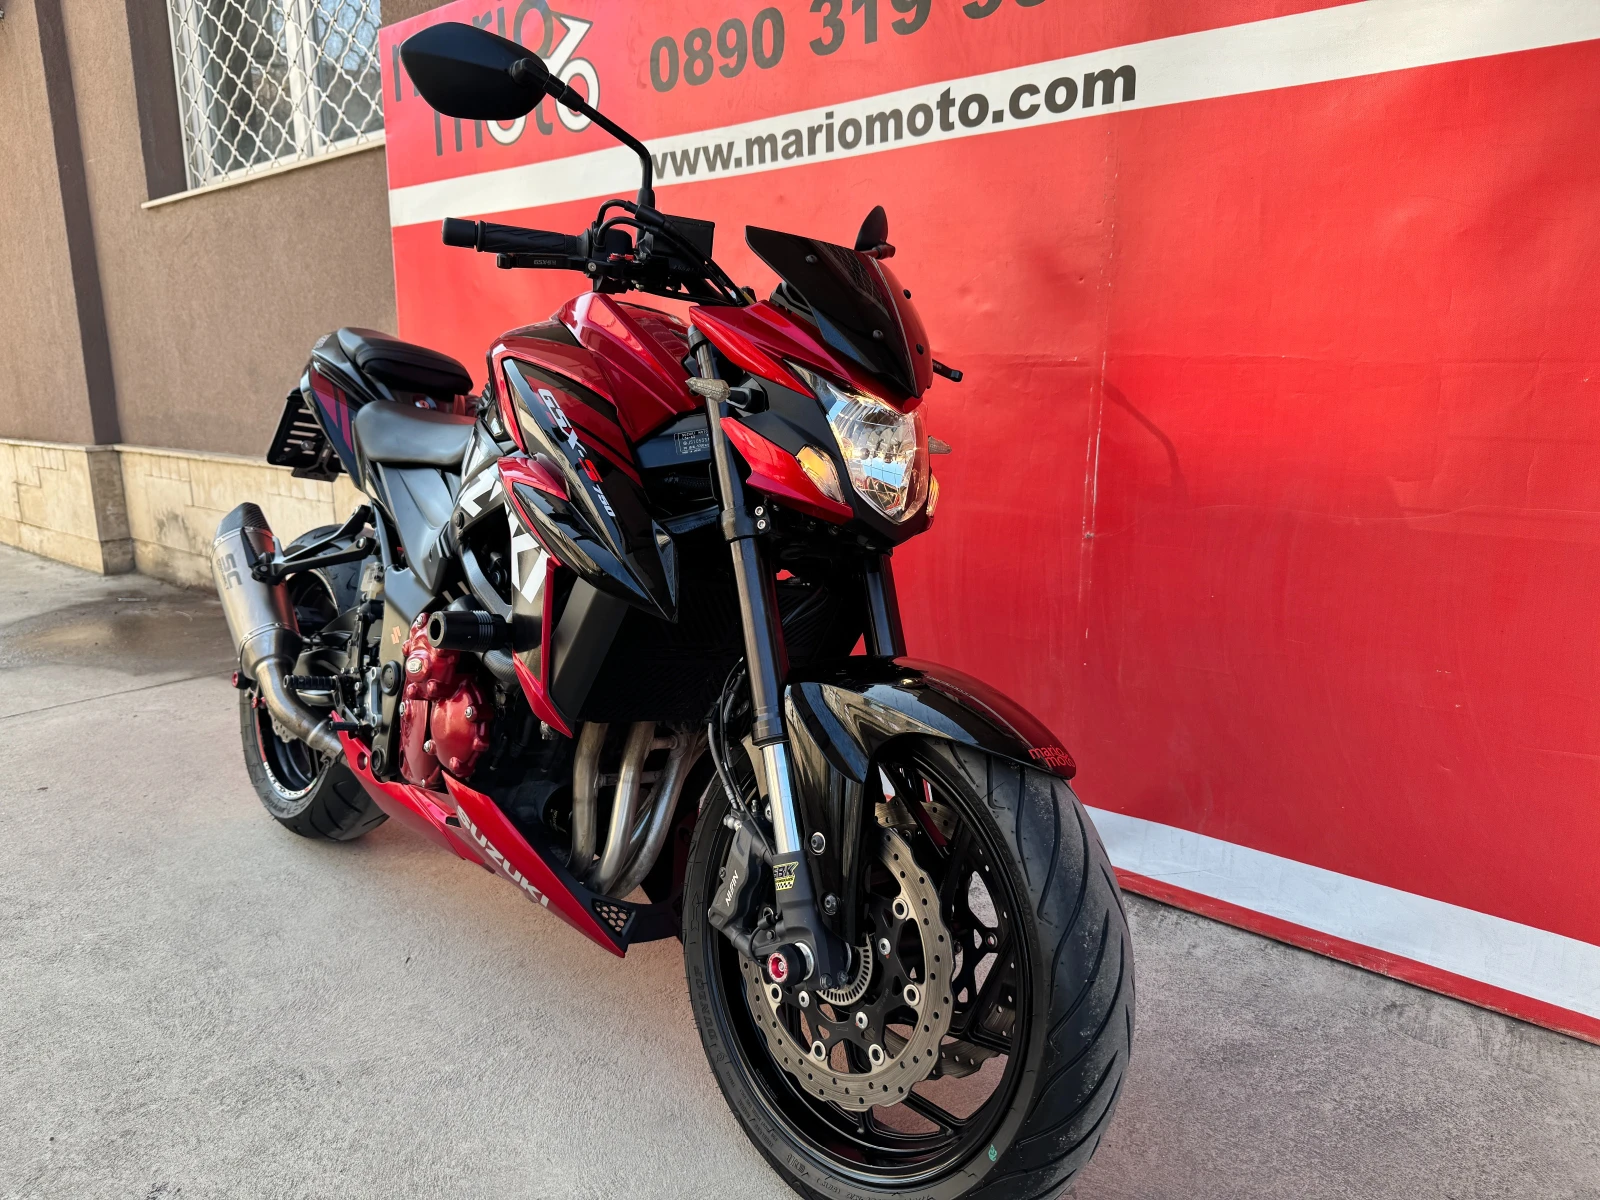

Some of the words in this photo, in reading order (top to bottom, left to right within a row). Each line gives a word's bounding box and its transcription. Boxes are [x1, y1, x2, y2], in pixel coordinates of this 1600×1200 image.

[650, 7, 785, 93] 0890
[809, 0, 932, 56] 319
[651, 63, 1137, 180] www.mariomoto.com
[592, 484, 616, 517] 750
[1028, 744, 1064, 759] mario
[1044, 753, 1076, 768] moto
[456, 804, 550, 908] SUZUKI
